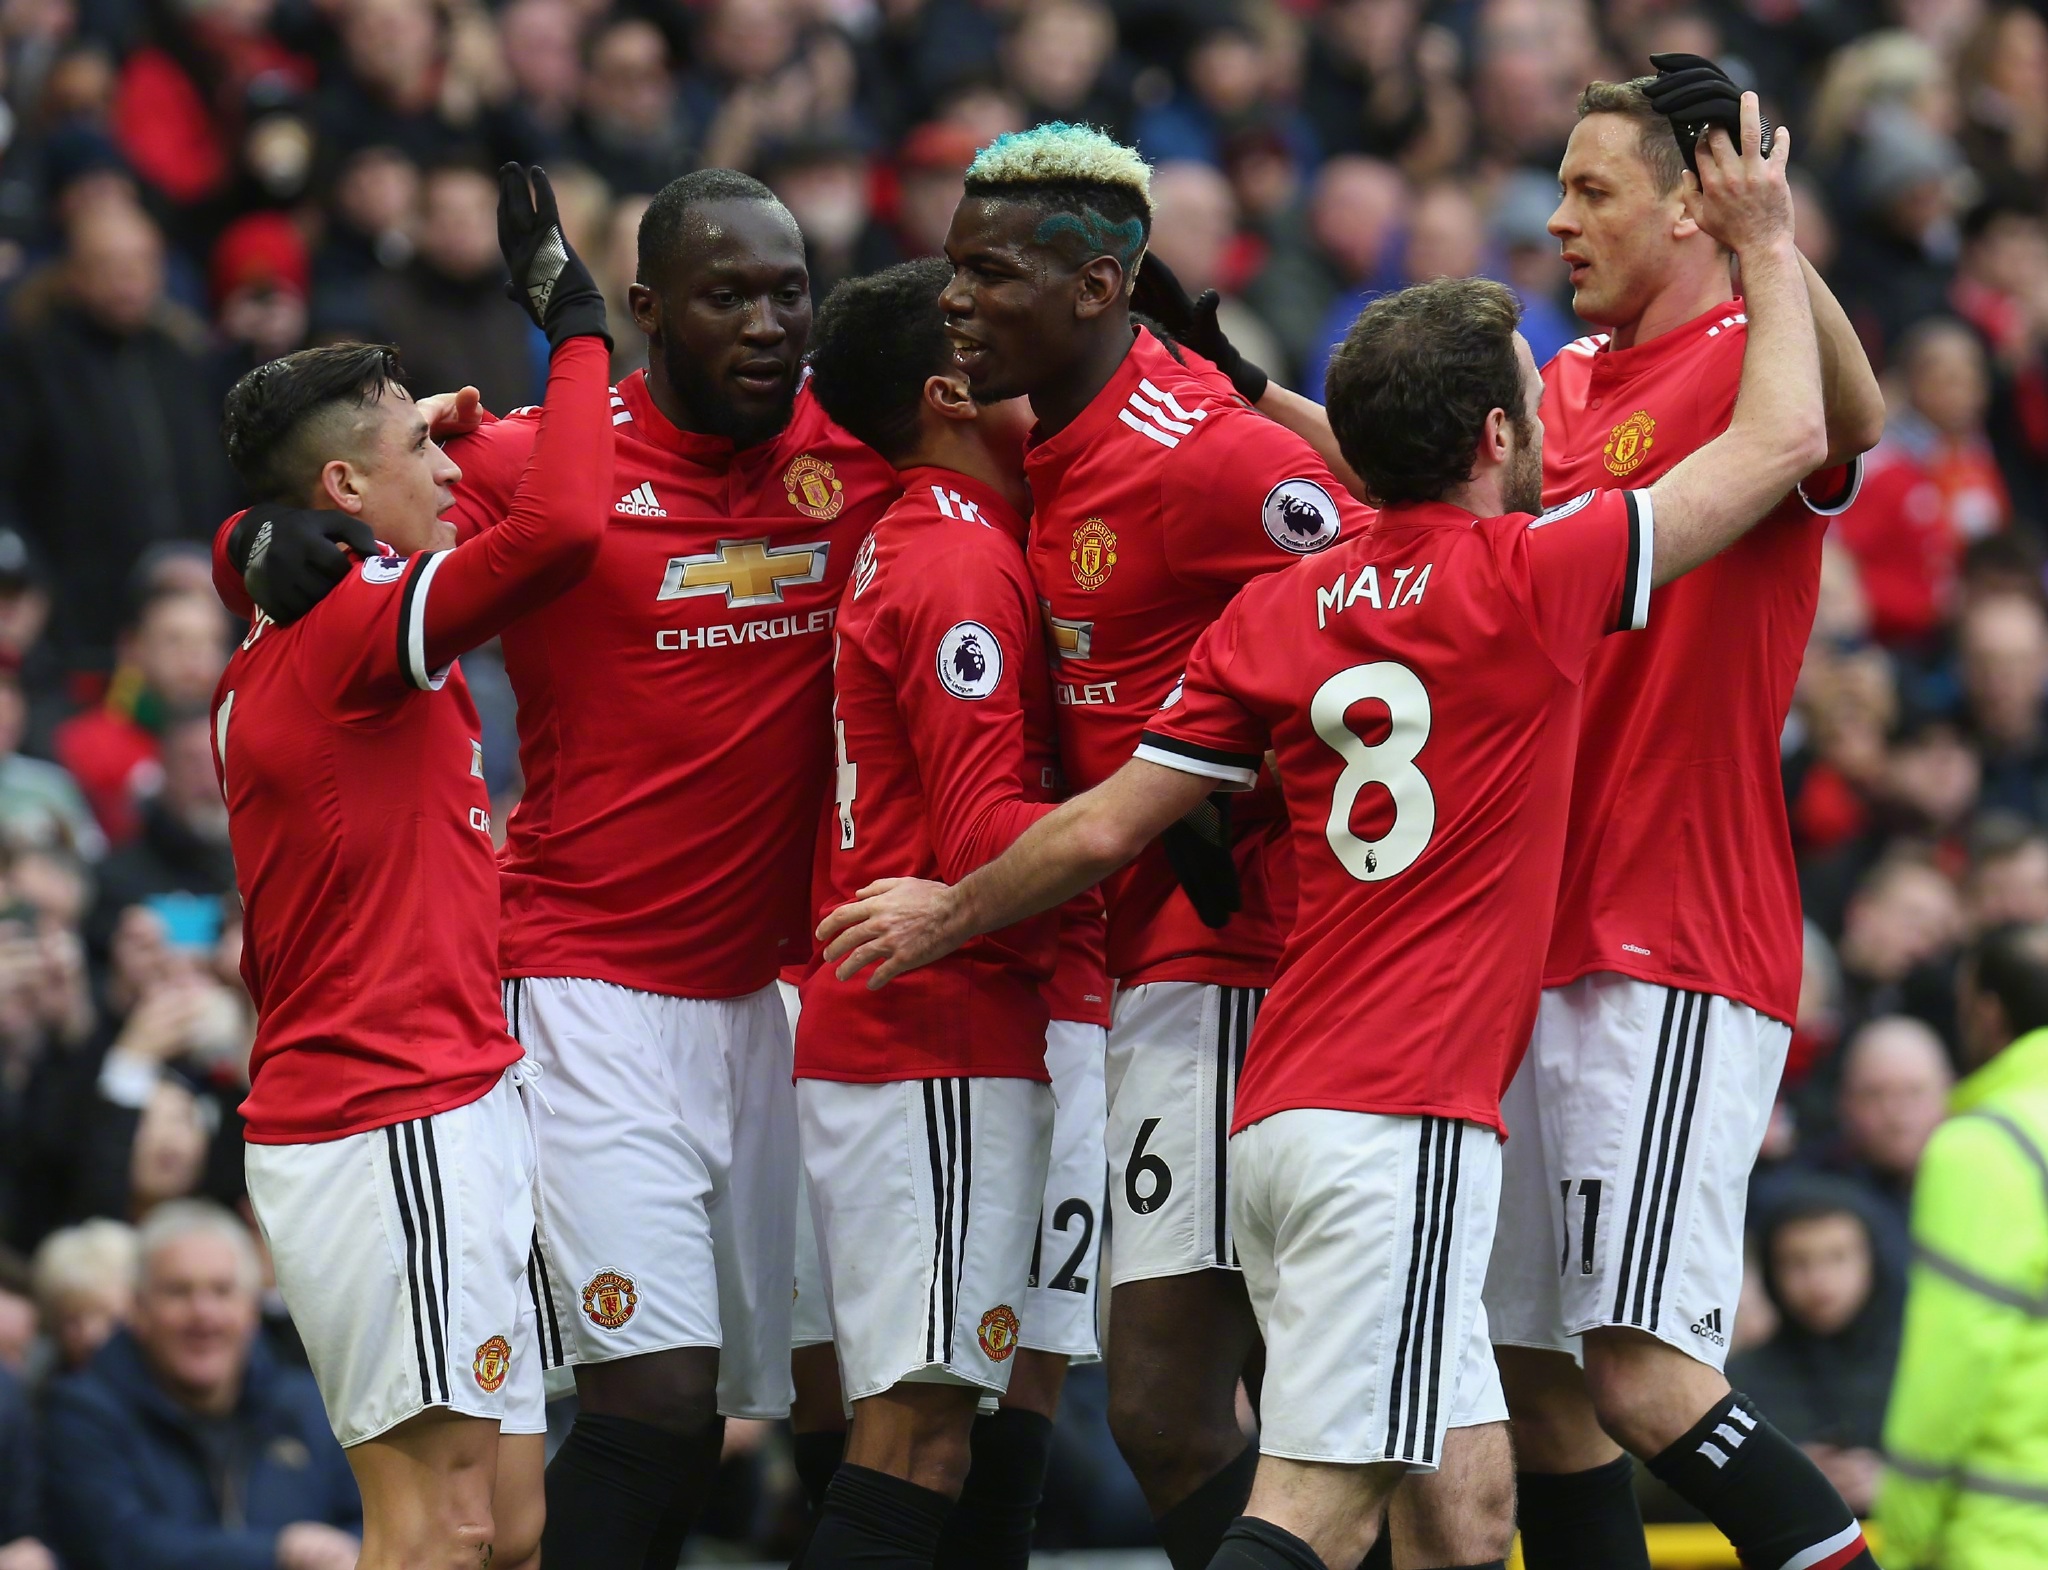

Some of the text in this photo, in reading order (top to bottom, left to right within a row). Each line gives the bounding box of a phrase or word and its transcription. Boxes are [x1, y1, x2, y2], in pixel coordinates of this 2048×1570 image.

[537, 279, 555, 326] didas
[788, 459, 830, 487] MANCHESTER
[1609, 458, 1639, 471] UNITED
[615, 502, 668, 518] adidas
[809, 501, 840, 517] UNITED
[1075, 522, 1113, 548] MANCHESTER
[1280, 533, 1329, 548] Premier League
[1077, 572, 1105, 585] UNITED
[1316, 563, 1433, 631] MATA
[656, 607, 838, 651] CHEVROLET
[943, 659, 974, 694] Premier League
[1310, 660, 1437, 883] 8
[1125, 1117, 1173, 1216] 6
[587, 1275, 630, 1298] MANCHESTER
[599, 1312, 629, 1325] UNITED
[1690, 1323, 1725, 1348] adidas
